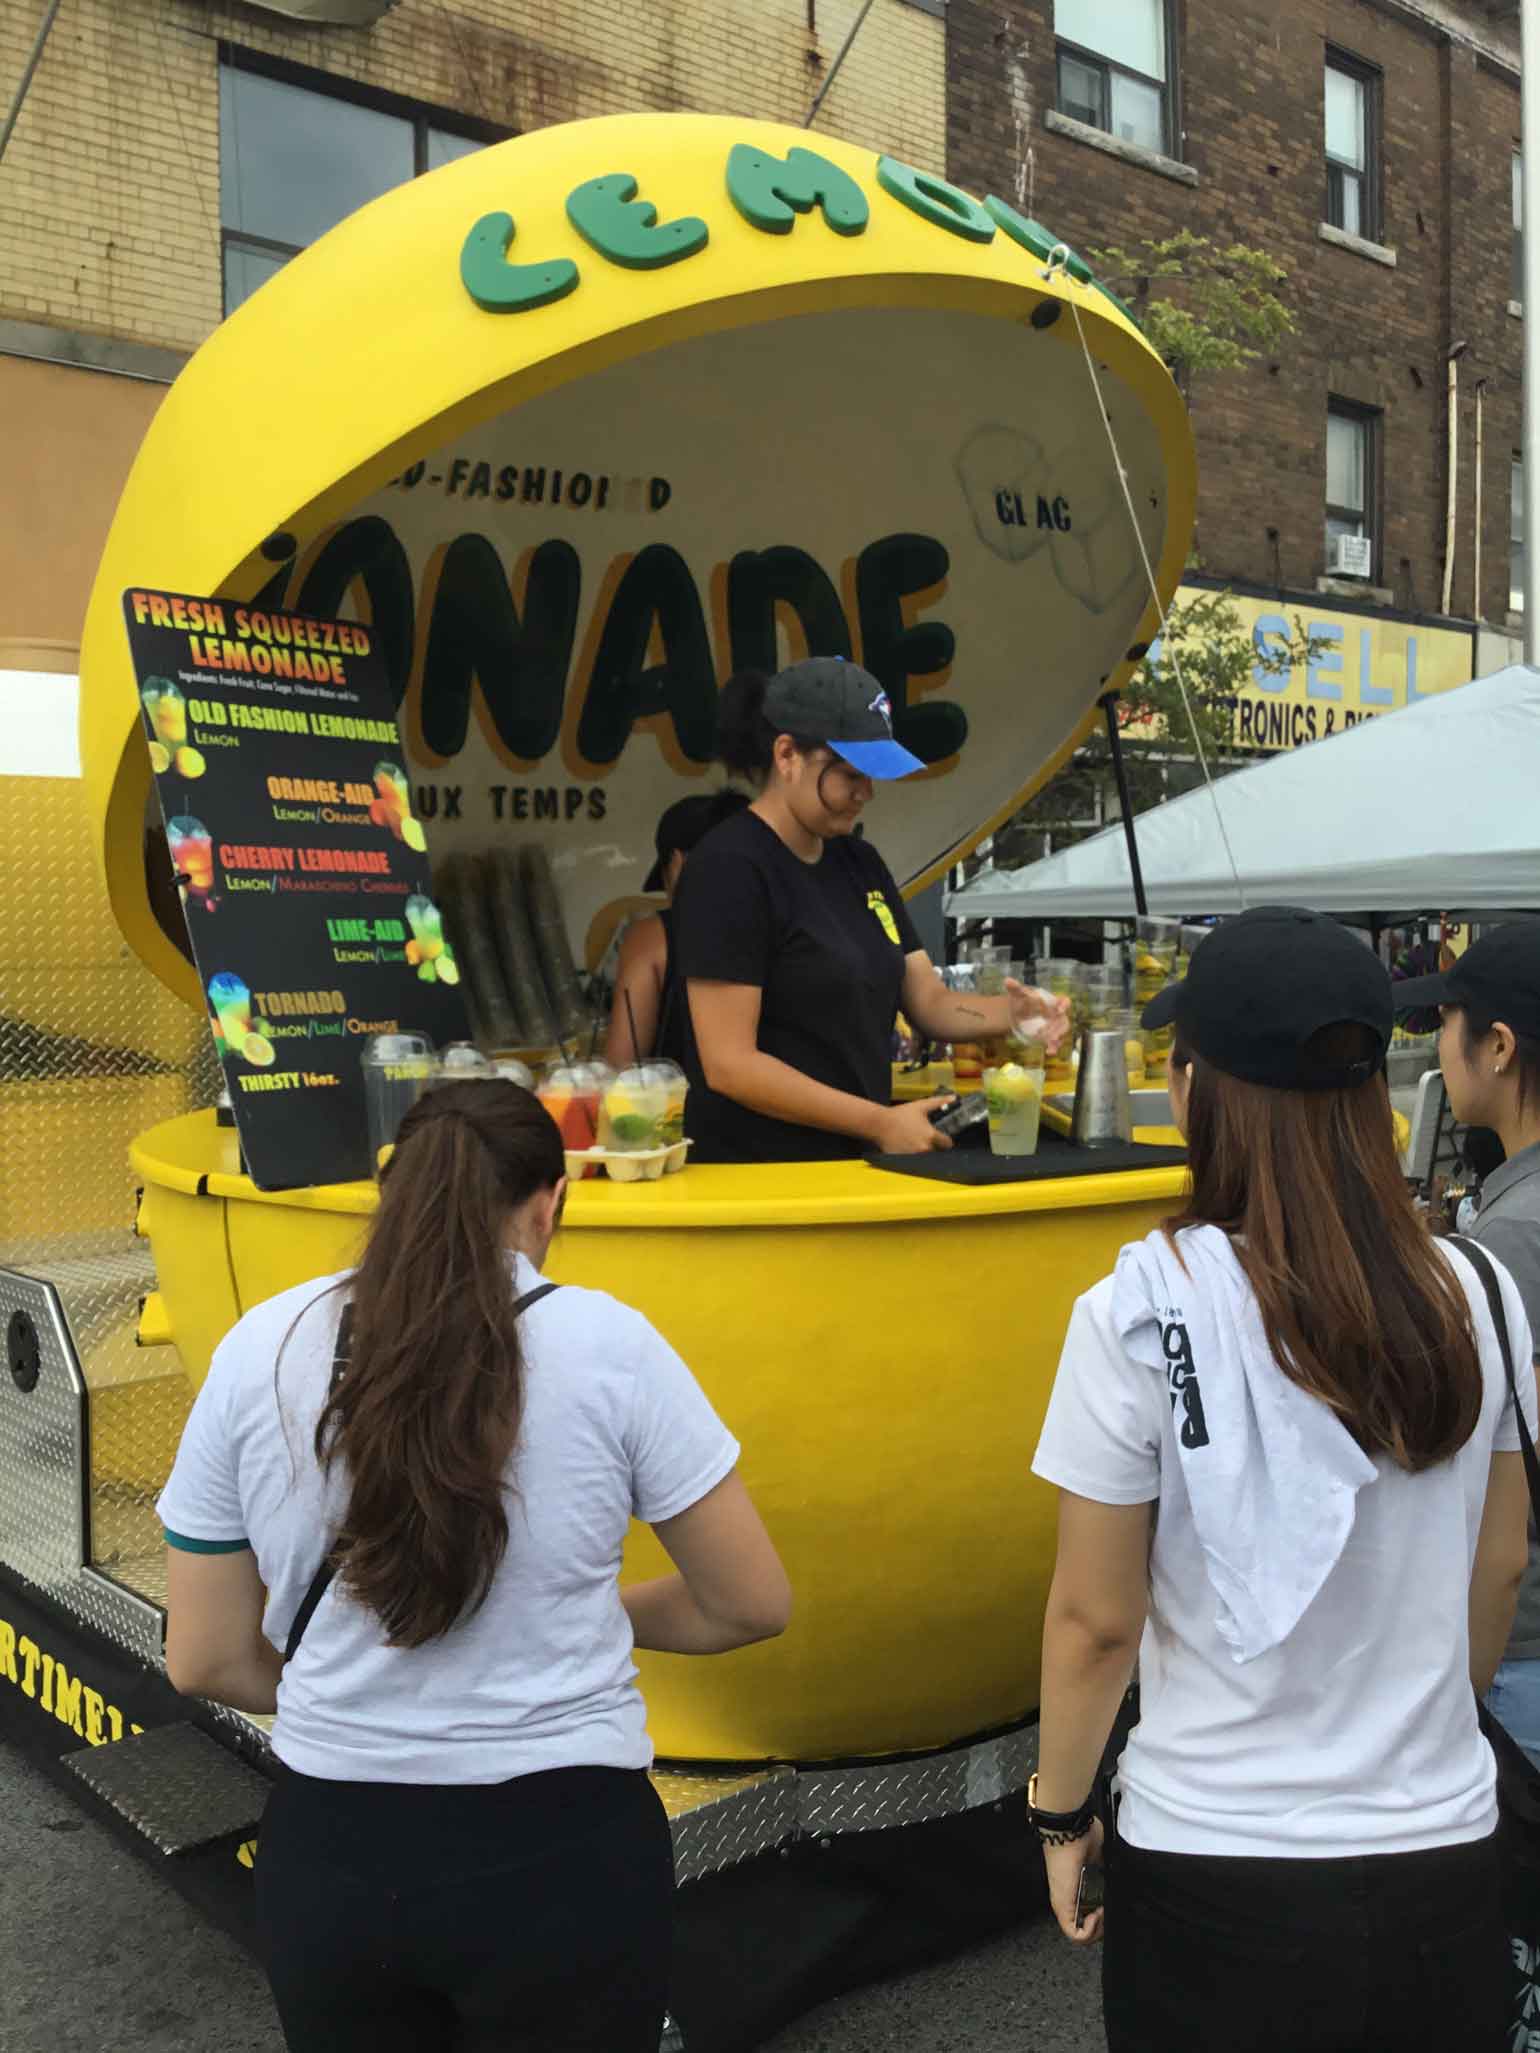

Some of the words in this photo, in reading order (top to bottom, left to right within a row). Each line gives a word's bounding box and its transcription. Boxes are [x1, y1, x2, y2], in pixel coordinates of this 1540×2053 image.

[131, 593, 226, 635] FRESH
[236, 609, 370, 656] SQUEEZED
[265, 515, 968, 770] ONADE
[188, 635, 347, 684] LEMONADE
[1252, 613, 1426, 706] SELL
[189, 699, 228, 726] OLD
[229, 703, 309, 735] FASHION
[311, 713, 400, 744] LEMONADE
[1202, 694, 1317, 746] TRONICS
[266, 775, 376, 806] ORANGE-AID
[490, 787, 608, 820] TEMPS
[219, 844, 295, 871] CHERRY
[298, 848, 392, 874] LEMONADE
[326, 918, 406, 941] LIME-AID
[254, 990, 347, 1017] TORNADO
[238, 1072, 300, 1092] THIRSTY
